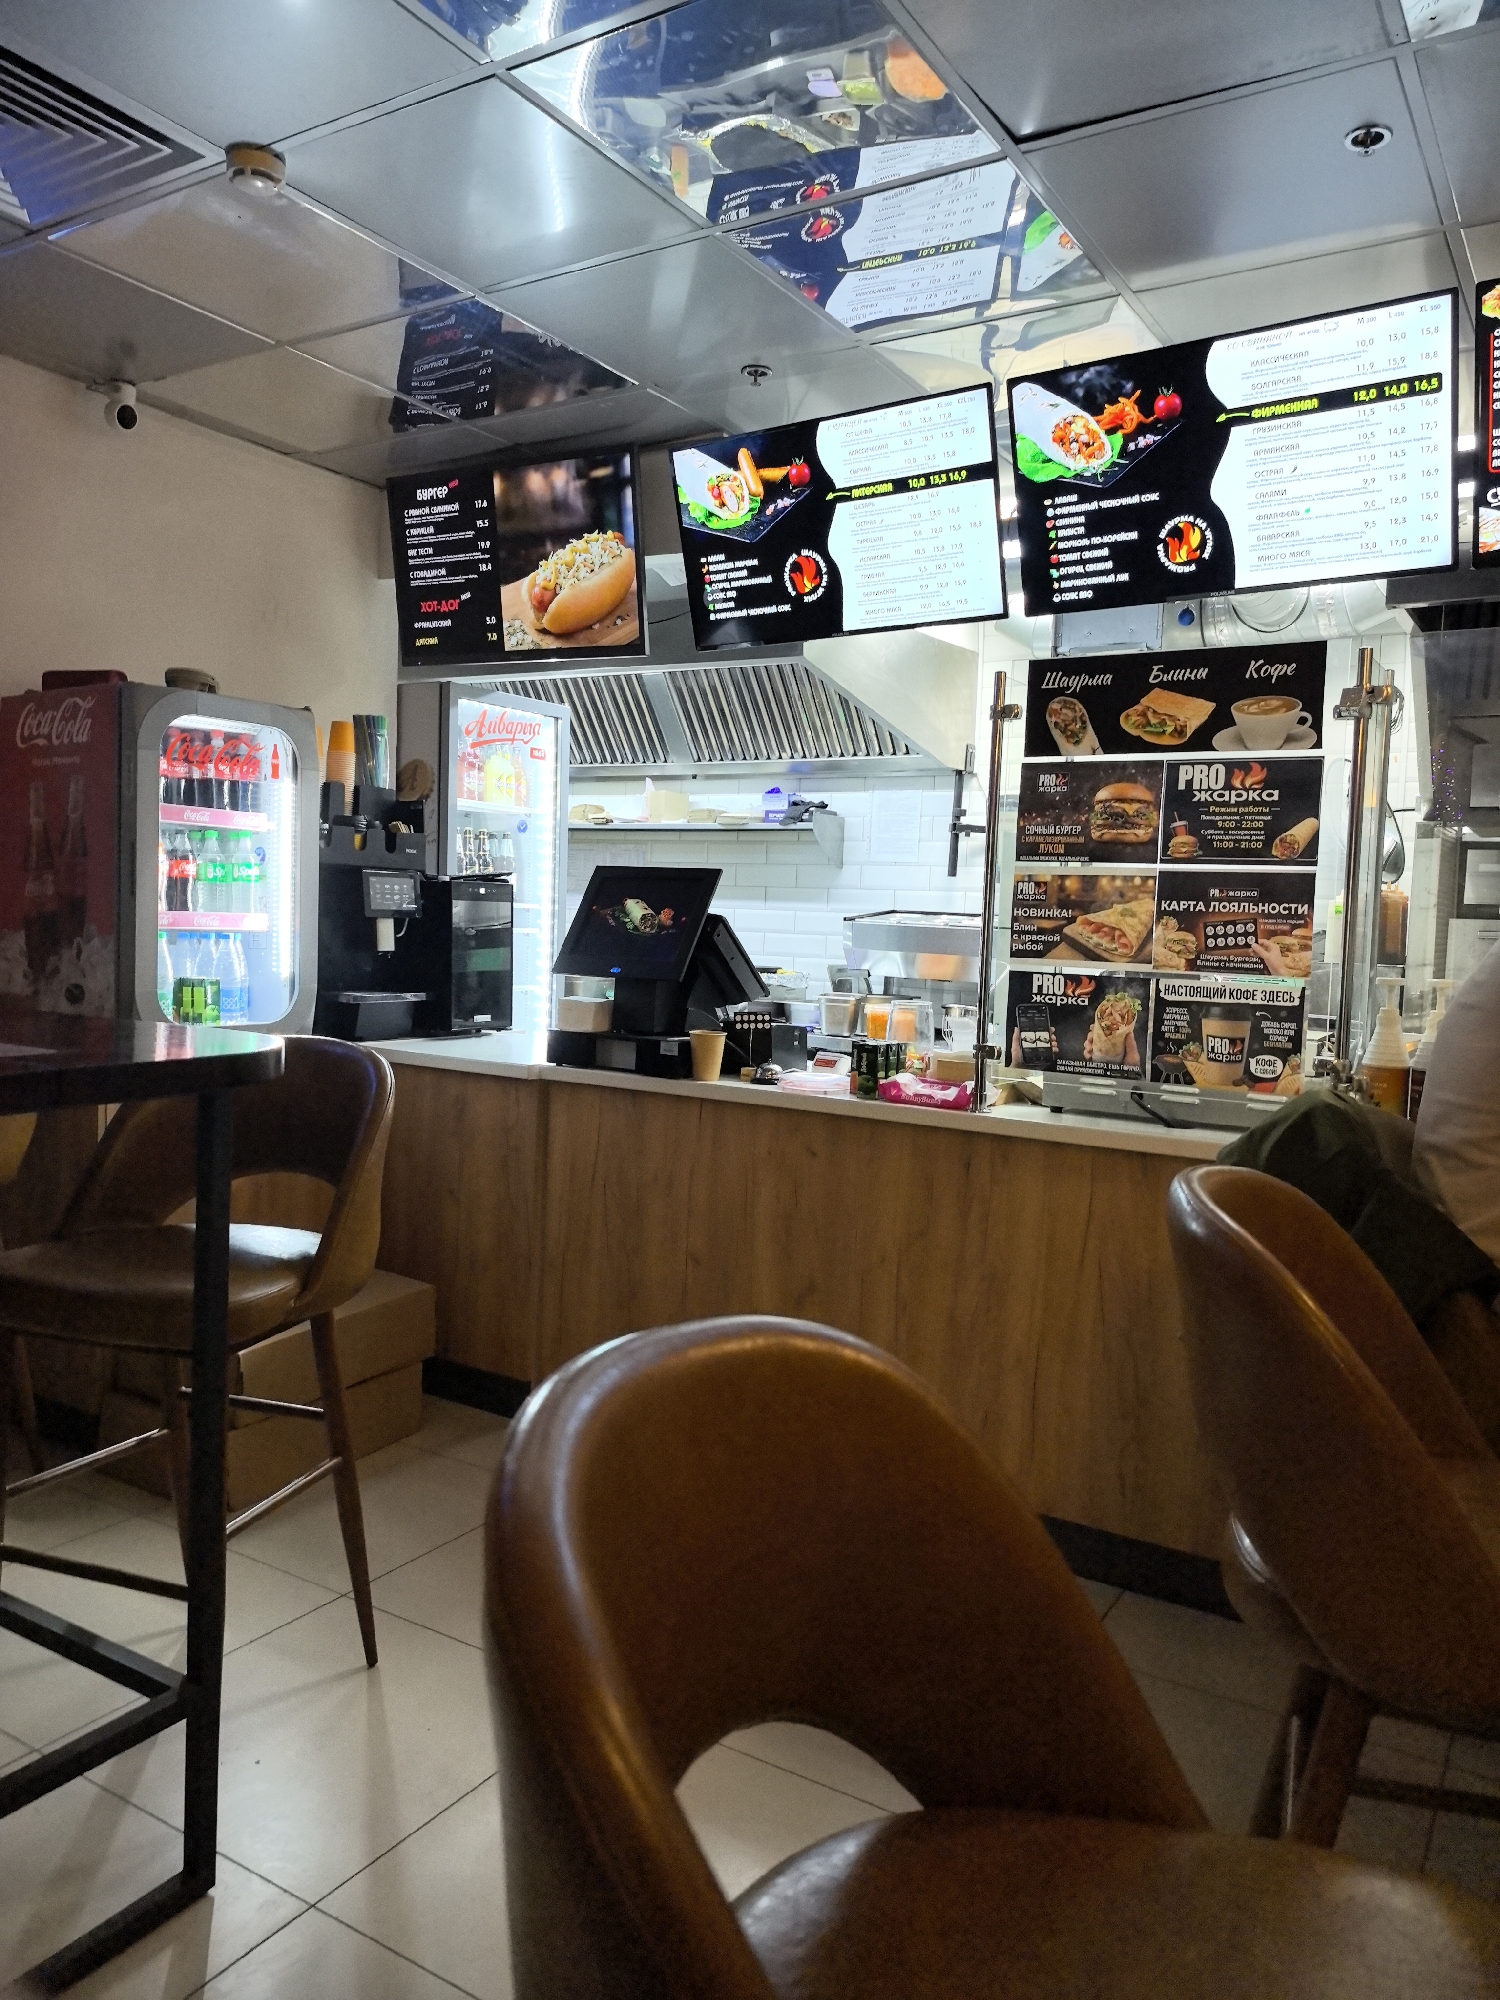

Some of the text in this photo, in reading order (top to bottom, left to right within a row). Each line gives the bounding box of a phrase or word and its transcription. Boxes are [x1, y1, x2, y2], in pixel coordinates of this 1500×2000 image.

[1251, 326, 1439, 368] КЛАССИЧЕСКАЯ 10,0 13,0 15,8
[1251, 351, 1438, 391] БОЛГАРСКАЯ 11,9 15,9 18,8
[1251, 378, 1438, 418] ФИРМЕННАЯ 12,0 14,0 16,5
[1253, 398, 1438, 435] ГРУЗИНСКАЯ 11,5 14,5 16,8
[1254, 422, 1438, 457] АРМЯНСКАЯ 10,5 14,2 17,7
[1254, 445, 1438, 478] ОСТРАЯ 11,0 14,5 17,8
[852, 483, 893, 498] ПИТЕРСКАЯ
[908, 478, 925, 489] 10,0
[930, 474, 947, 485] 13,3
[949, 470, 967, 482] 16,9
[1255, 489, 1286, 500] САЛЯМИ
[1363, 478, 1376, 486] 9,9
[417, 486, 448, 500] БУРГЕР
[1054, 494, 1078, 504] ЛАВАШ
[475, 500, 488, 508] 17.6
[1055, 492, 1159, 515] ФИРМЕННЫЙ ЧЕСНОЧНЫЙ СОУС
[1256, 510, 1300, 521] ФАЛАФЕЛЬ
[1390, 496, 1407, 504] 12,0
[1421, 491, 1438, 500] 15,0
[1056, 515, 1085, 526] СВИНИНА
[1257, 513, 1438, 542] БАВАРСКАЯ 9,5 12,3 14,9
[1058, 526, 1085, 537] КАПУСТА
[1091, 531, 1138, 544] ПО-КОРЕЙСКИ
[1159, 514, 1213, 560] ШАУРМА НА УГЛЯХ
[478, 541, 490, 549] 19.9
[1257, 535, 1438, 562] МНОГО МЯСА 13,0 17,0 21,0
[1059, 547, 1109, 562] ТОМАТ СВЕЖИЙ
[479, 563, 492, 572] 18.4
[1060, 560, 1113, 575] ОГУРЕЦ СВЕЖИЙ
[1116, 573, 1129, 582] ЛУК
[421, 599, 460, 612] ХОТ-ДОГ
[486, 616, 496, 624] 5.0
[487, 633, 497, 641] 7.0
[1041, 671, 1113, 693] Шаурма
[1245, 659, 1296, 683] Кофе
[16, 696, 97, 748] Coca-Cola
[1039, 774, 1056, 786] PRO
[1178, 764, 1225, 790] PRO
[1192, 790, 1279, 804] жарка
[1026, 824, 1081, 835] СОЧНЫЙ БУРГЕР
[1038, 844, 1064, 854] ЛУКОМ
[1018, 882, 1034, 894] PRO
[1014, 908, 1072, 917] НОВИНКА!
[1161, 900, 1308, 915] КАРТА ЛОЯЛЬНОСТИ
[1013, 923, 1037, 931] Блин
[1020, 934, 1060, 942] красной
[1012, 942, 1043, 951] рыбой
[1032, 974, 1064, 995] PRO
[1031, 994, 1089, 1006] жарка
[1164, 984, 1295, 1003] НАСТОЯЩИЙ КОФЕ ЗДЕСЬ
[1208, 1037, 1230, 1054] PRO
[1208, 1053, 1242, 1062] жарка
[1256, 1058, 1277, 1068] КОФЕ
